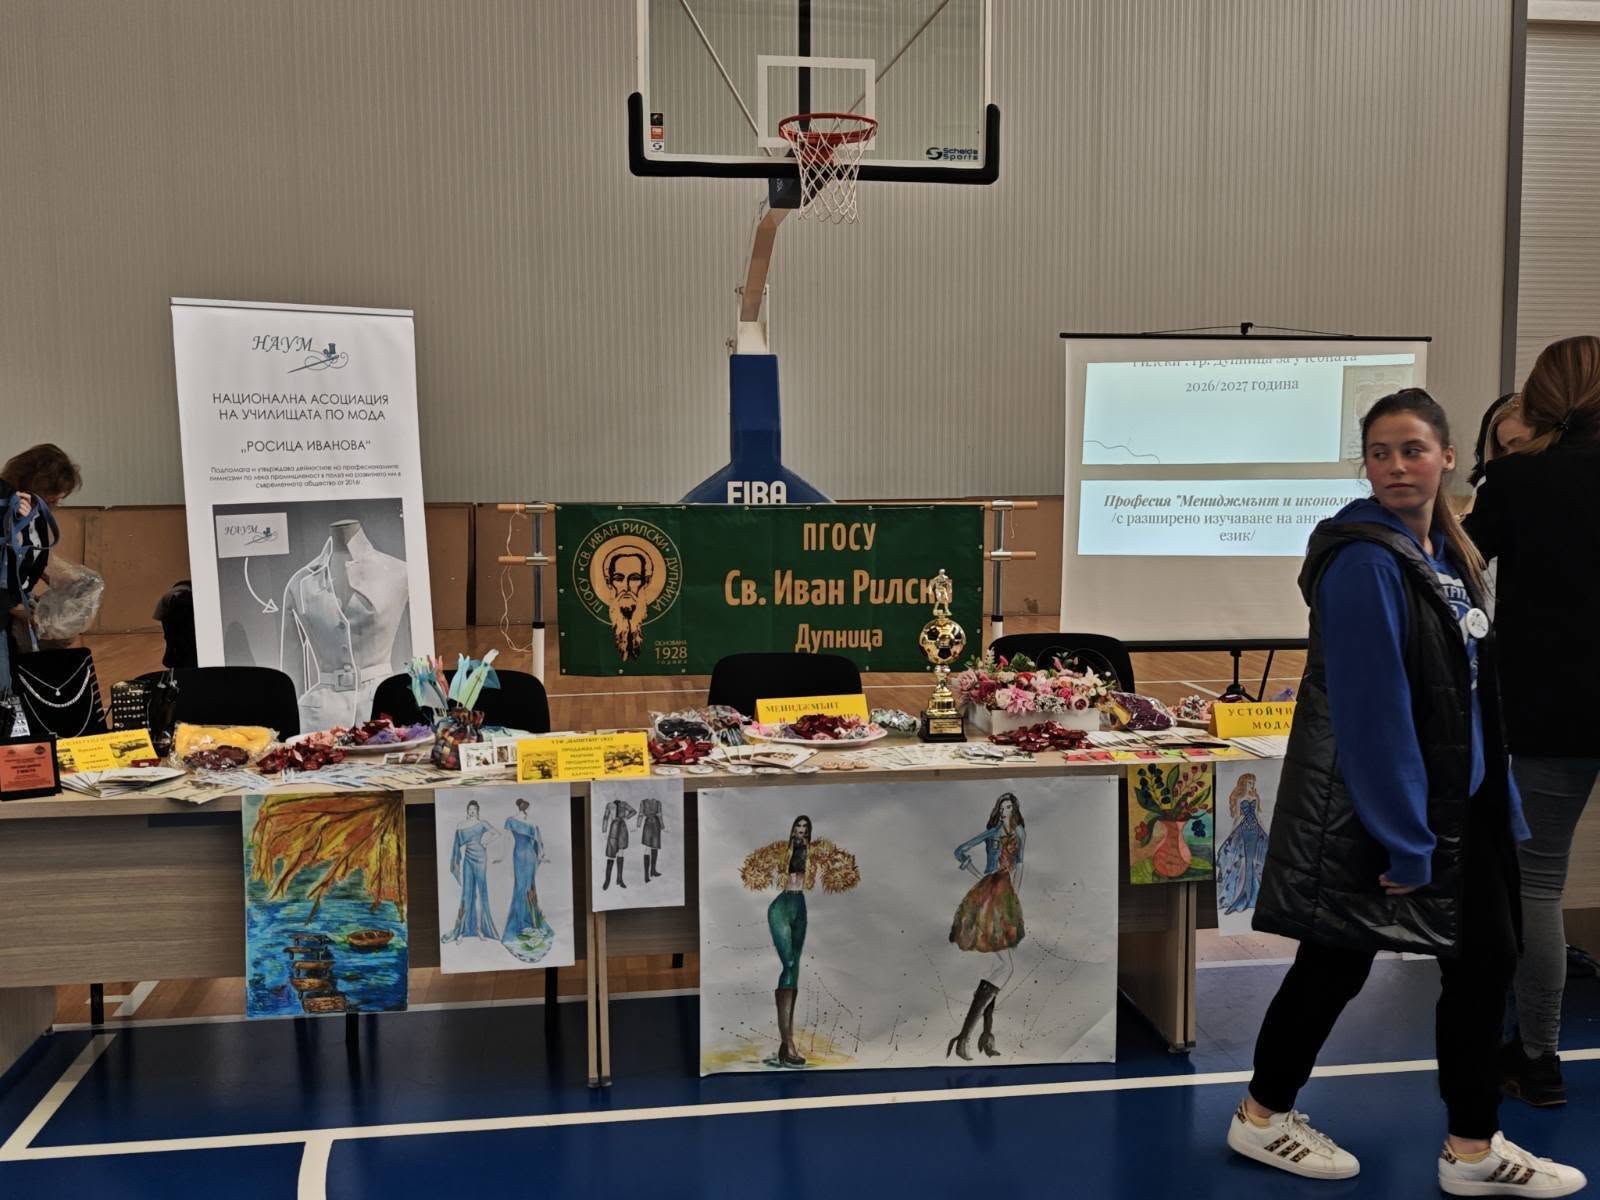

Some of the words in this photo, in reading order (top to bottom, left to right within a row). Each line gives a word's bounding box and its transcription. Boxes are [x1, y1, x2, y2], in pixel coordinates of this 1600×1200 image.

[252, 334, 313, 353] НАУМ
[1185, 380, 1249, 393] 2026/2027
[1251, 379, 1300, 392] година
[213, 393, 307, 405] НАЦИОНАЛНА
[311, 394, 389, 406] АСОЦИАЦИЯ
[219, 409, 239, 420] НА
[242, 409, 322, 422] УЧИЛИЩАТА
[325, 409, 344, 420] ПО
[348, 409, 386, 421] МОДА
[241, 440, 303, 454] „РОСИЦА
[727, 480, 787, 505] FIBA
[1103, 494, 1172, 509] Професия
[1282, 496, 1291, 507] и
[1126, 513, 1201, 527] разширено
[1203, 513, 1274, 526] изучаване
[1277, 514, 1290, 524] на
[588, 524, 619, 549] ИВАН
[622, 522, 669, 549] РИЛСКИ
[803, 522, 877, 551] ПГОСУ
[1219, 528, 1256, 542] език/
[652, 557, 680, 612] ДУПНИЦА
[724, 569, 767, 606] Св.
[774, 569, 845, 605] Иван
[577, 577, 604, 614] ПГОСУ
[795, 623, 883, 654] Дупница
[655, 646, 688, 660] 1928
[1252, 721, 1291, 731] МОДА
